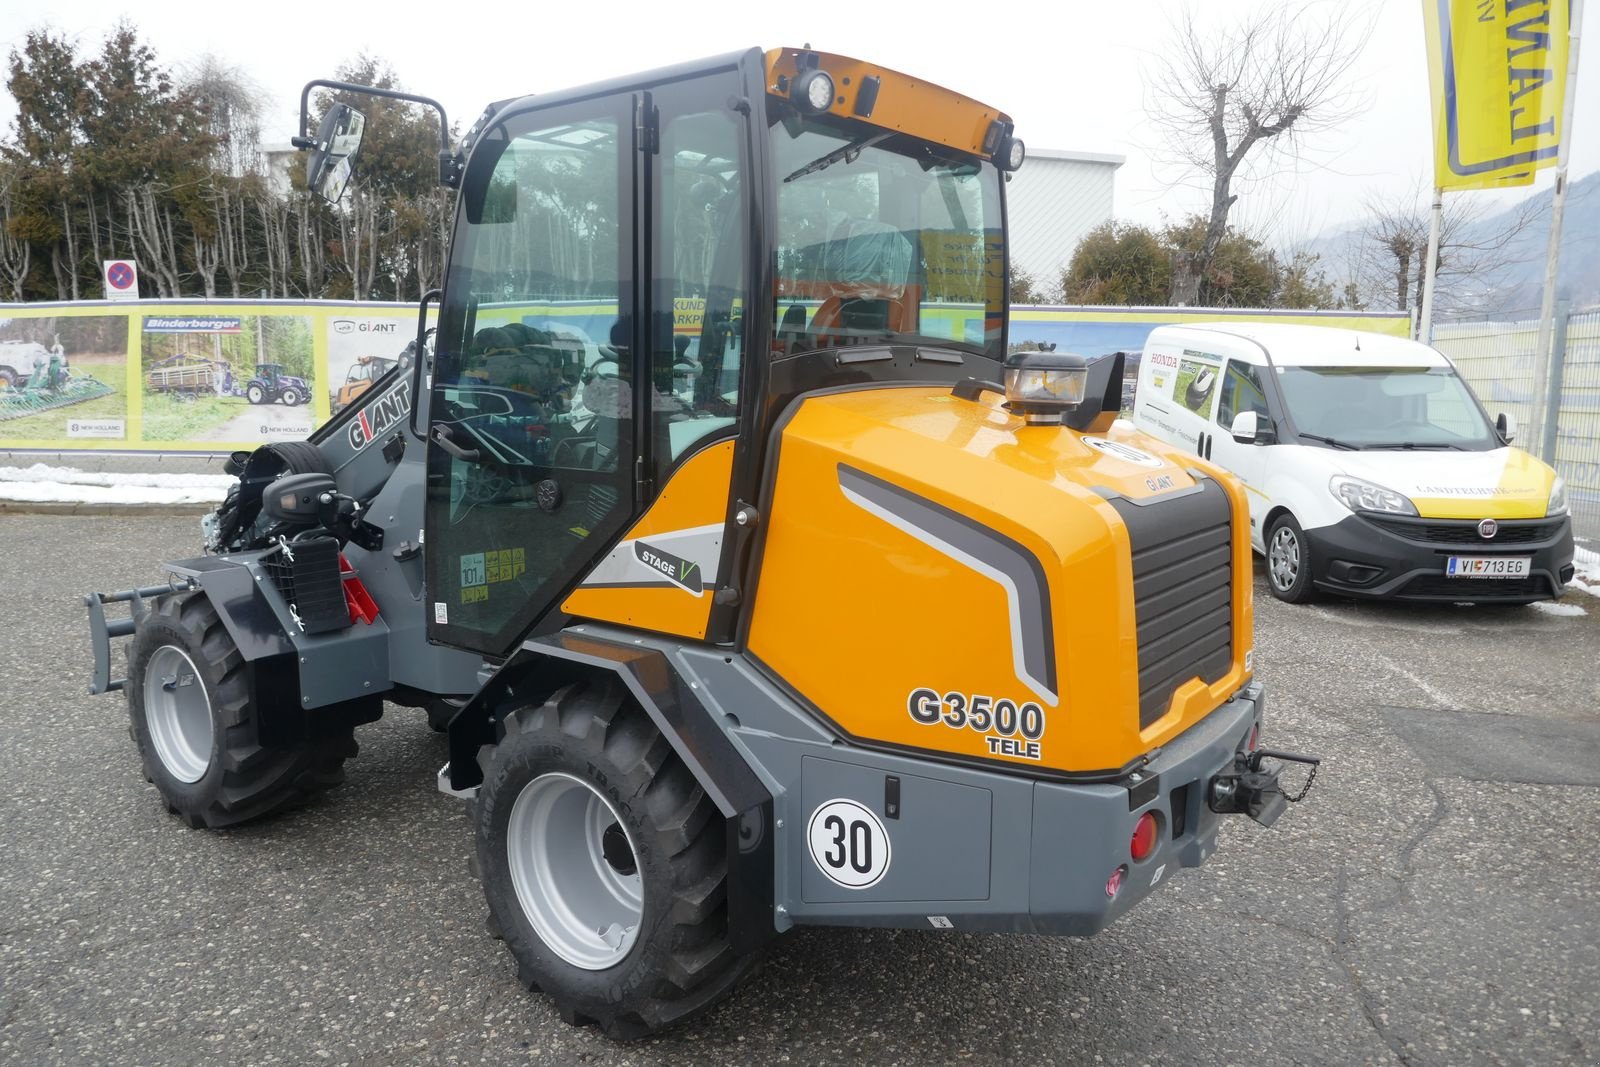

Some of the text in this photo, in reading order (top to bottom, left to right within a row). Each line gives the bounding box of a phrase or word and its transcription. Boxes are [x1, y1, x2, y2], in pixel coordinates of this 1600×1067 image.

[147, 319, 239, 331] Binderberger
[1151, 353, 1178, 368] HONDA
[462, 567, 478, 585] 101
[641, 550, 698, 582] STAGE V
[1462, 560, 1523, 573] VI 713 EG
[907, 687, 1045, 741] G3500
[986, 736, 1042, 760] TELE
[824, 814, 873, 874] 30
